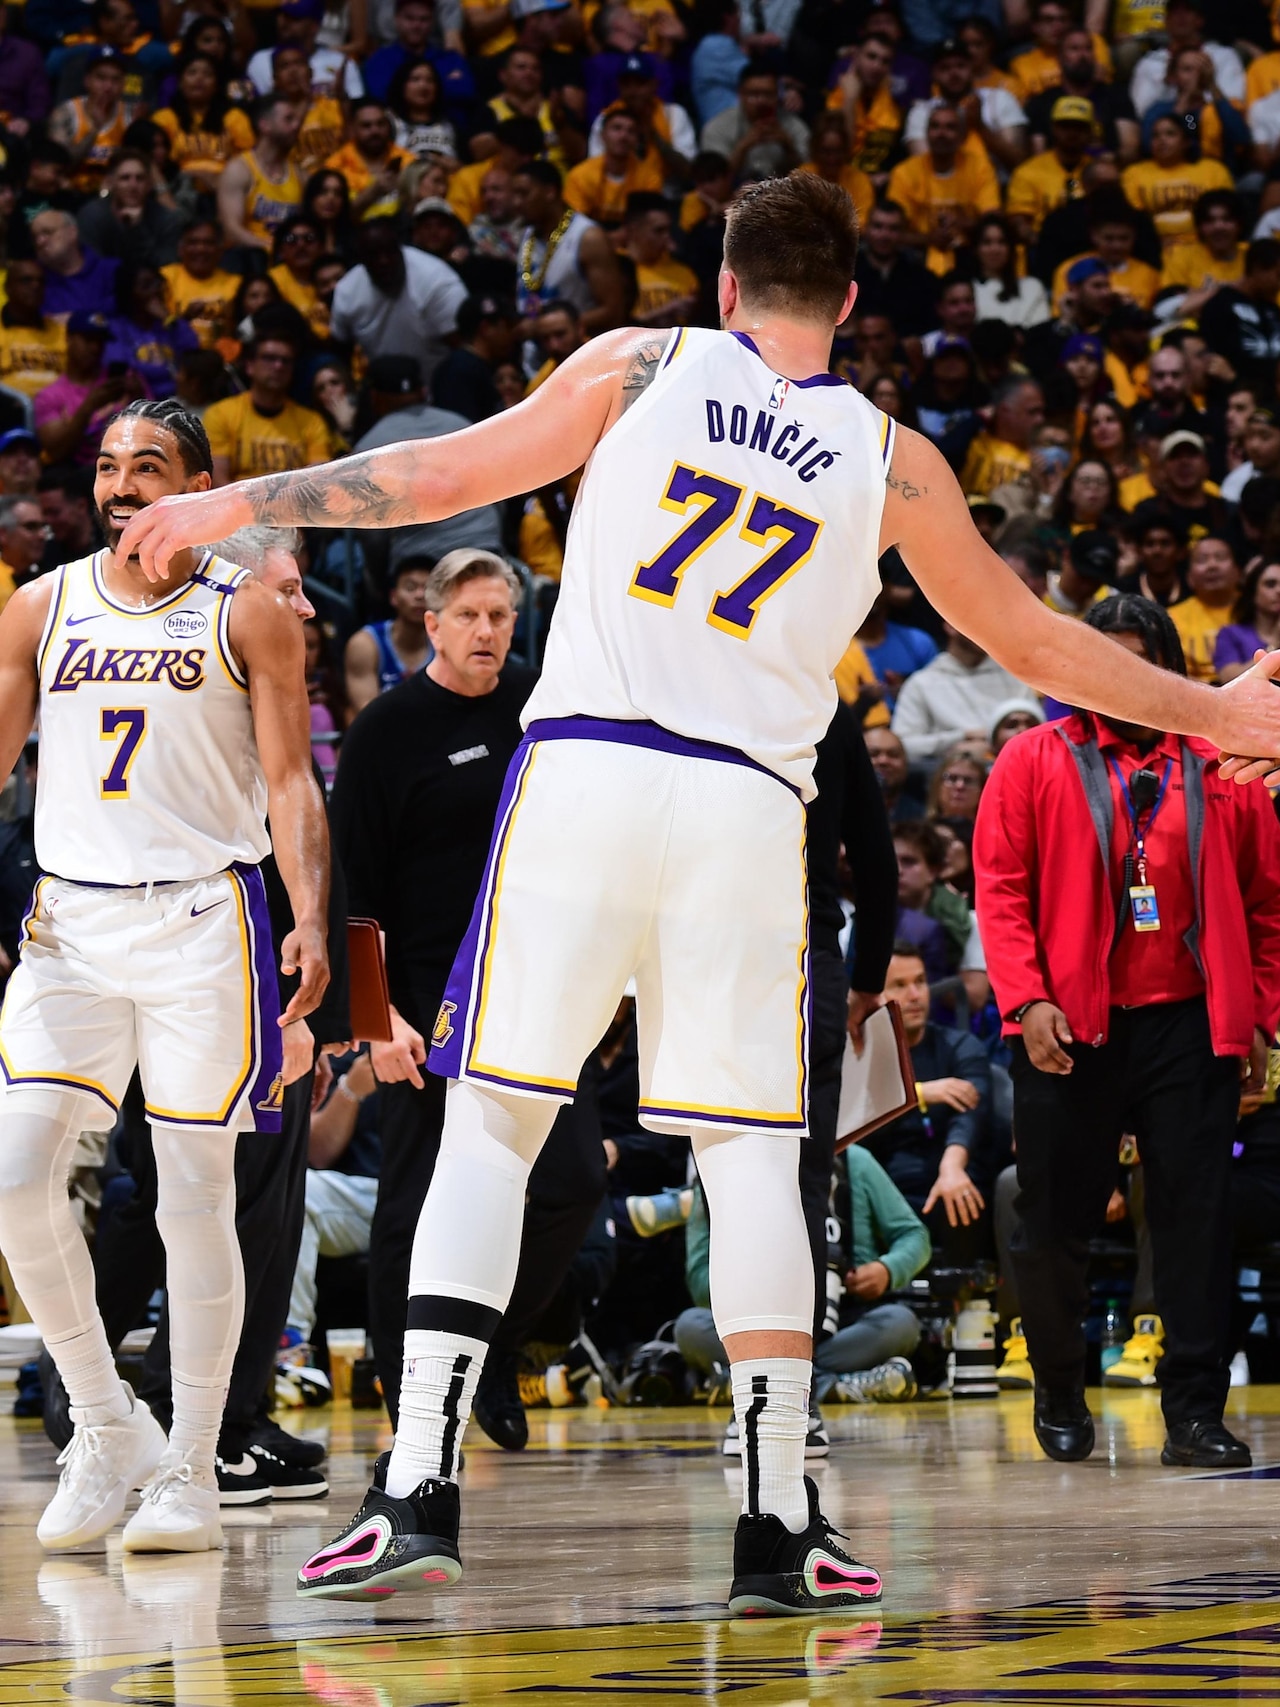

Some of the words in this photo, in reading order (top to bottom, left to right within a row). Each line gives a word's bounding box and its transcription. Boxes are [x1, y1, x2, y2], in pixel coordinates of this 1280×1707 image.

[705, 399, 843, 483] DONČIĆ
[627, 460, 825, 642] 77
[48, 637, 207, 694] LAKERS
[168, 618, 205, 630] bibigo
[99, 706, 148, 801] 7
